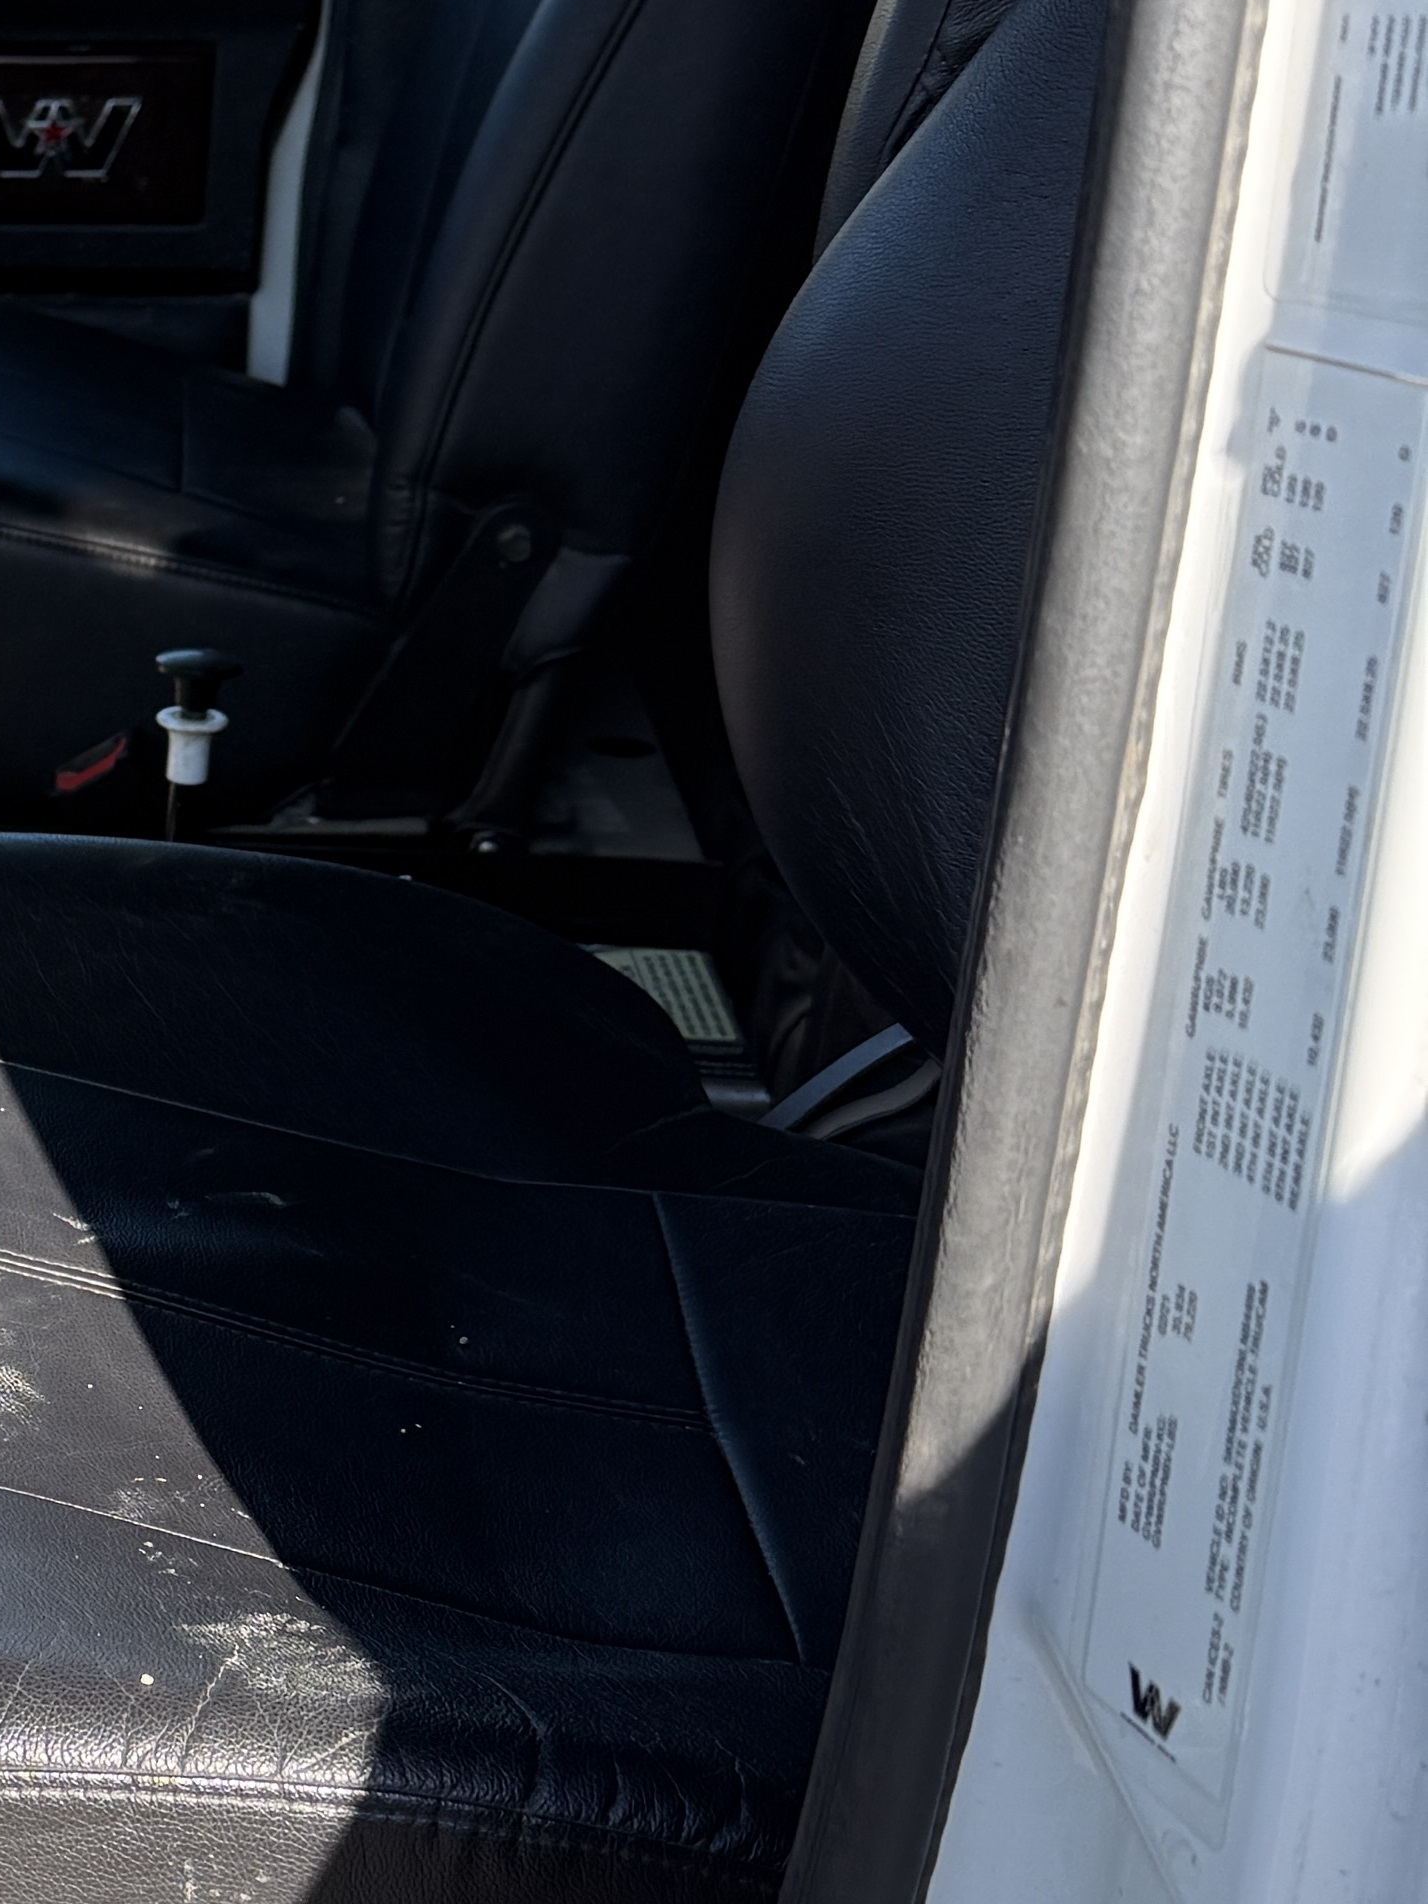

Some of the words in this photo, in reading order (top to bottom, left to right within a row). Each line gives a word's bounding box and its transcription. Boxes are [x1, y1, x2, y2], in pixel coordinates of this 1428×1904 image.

[1164, 1118, 1179, 1156] LLC
[1191, 1094, 1209, 1156] FRONT
[1153, 1156, 1174, 1231] AMERICA
[1146, 1230, 1164, 1293] NORTH
[1137, 1293, 1156, 1361] TRUCKS
[1127, 1362, 1147, 1435] DAIMLER
[1135, 1462, 1147, 1489] OF
[1221, 1436, 1247, 1546] INCOMPLETE
[1238, 1361, 1258, 1436] VEHICLE
[1202, 1523, 1222, 1595] VEHICLE
[1228, 1529, 1251, 1615] COUNTRY
